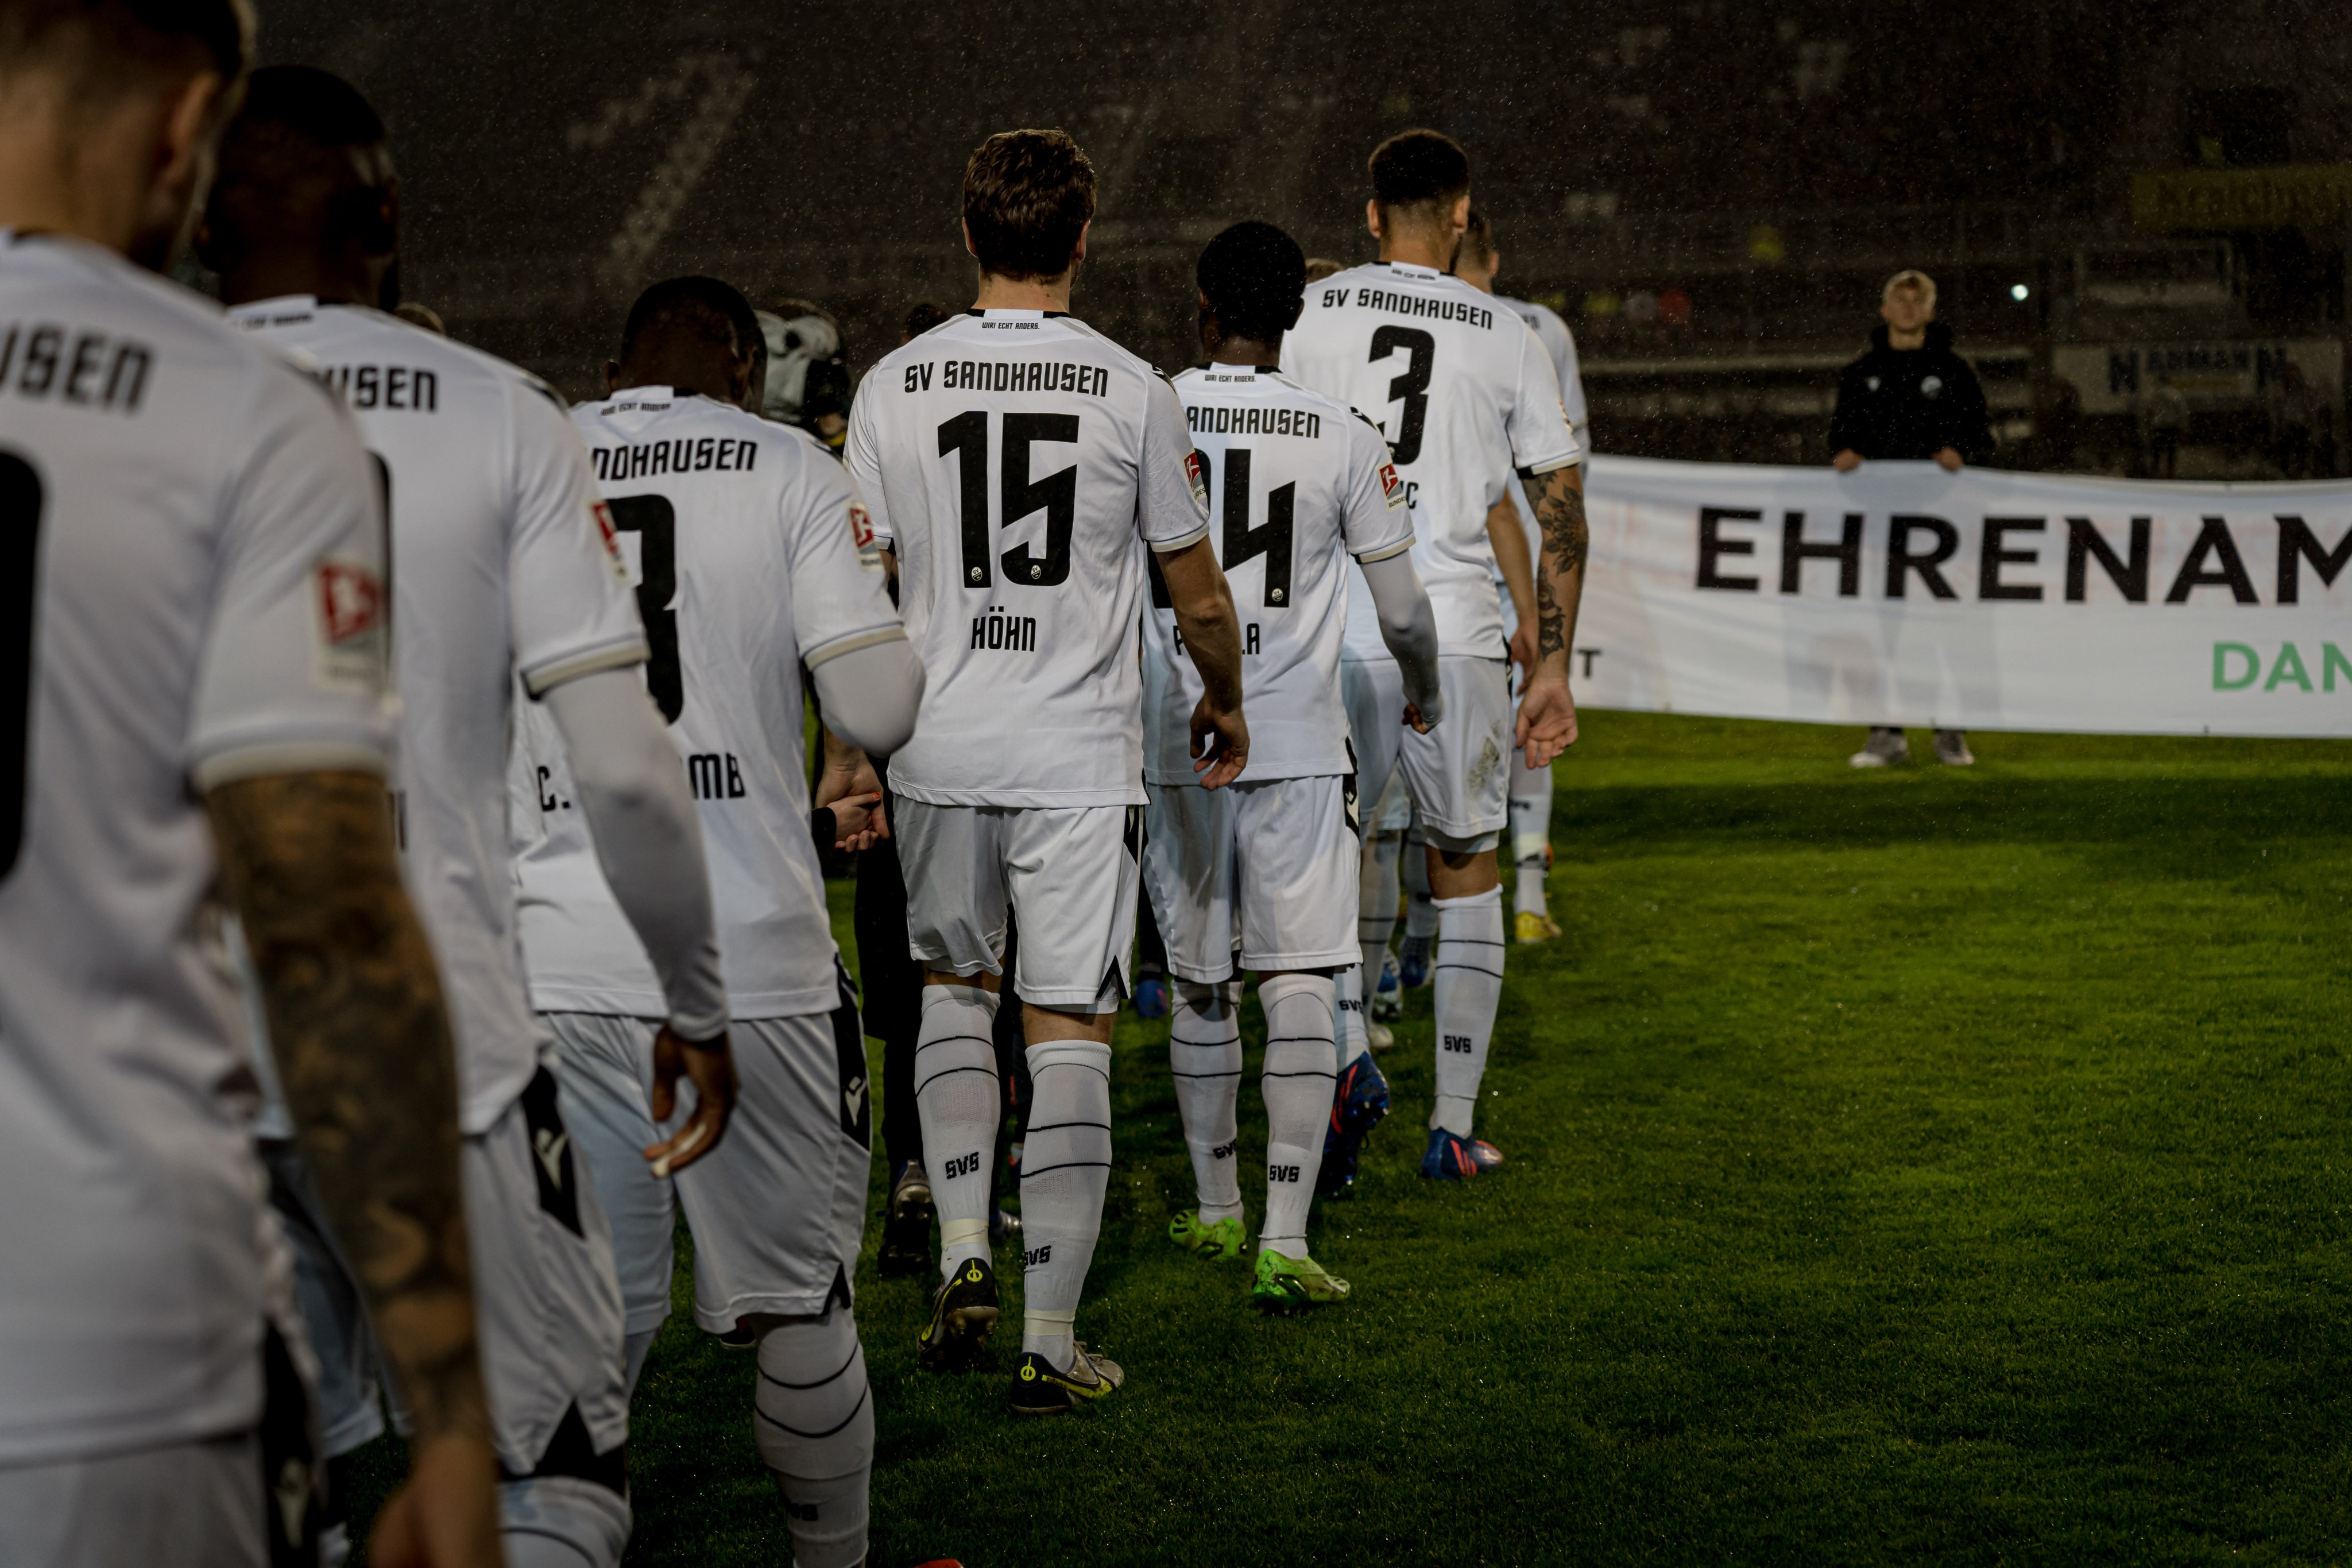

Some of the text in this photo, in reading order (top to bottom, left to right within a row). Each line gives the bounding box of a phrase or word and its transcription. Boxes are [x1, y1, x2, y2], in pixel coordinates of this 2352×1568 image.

[1322, 289, 1349, 307] SV
[1357, 289, 1492, 330] SANDHAUSEN
[904, 361, 1108, 397] SV SANDHAUSEN
[1368, 324, 1434, 465] 3
[1187, 406, 1320, 439] ANDHAUSEN
[593, 439, 757, 480] NDHAUSEN
[938, 411, 1080, 588] 15
[1698, 508, 2352, 604] EHRENAM
[971, 606, 1036, 651] HÖHN
[537, 765, 571, 811] C.
[1444, 1035, 1471, 1054] SVS
[945, 1152, 979, 1180] SVS
[1270, 1165, 1300, 1183] SVS
